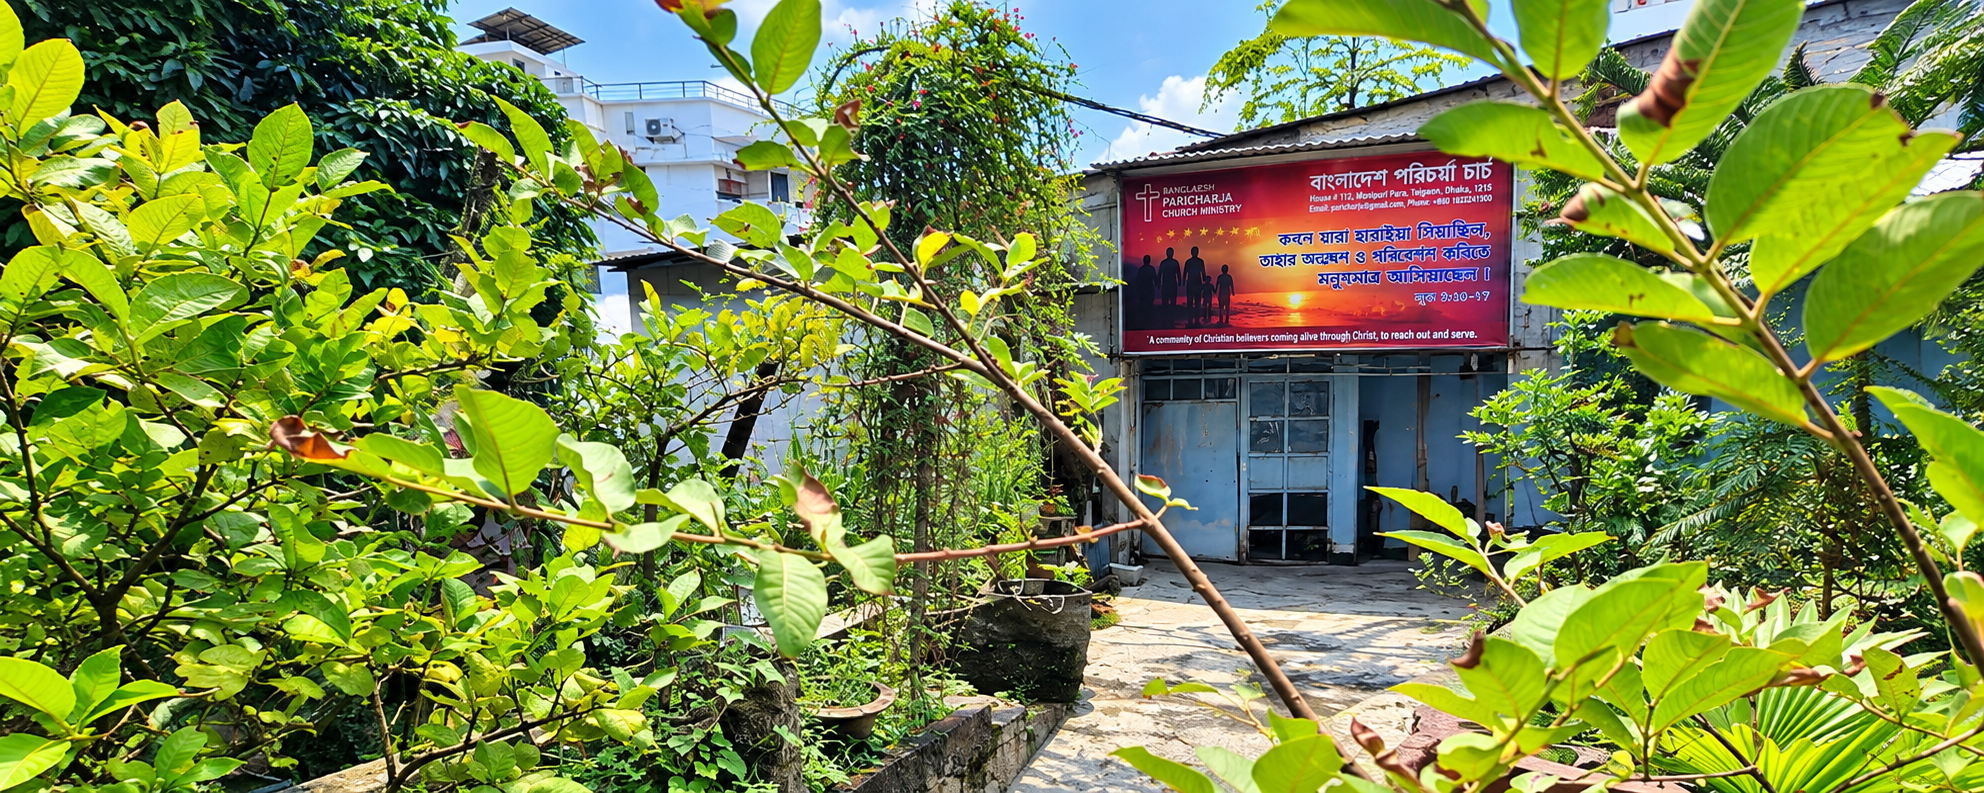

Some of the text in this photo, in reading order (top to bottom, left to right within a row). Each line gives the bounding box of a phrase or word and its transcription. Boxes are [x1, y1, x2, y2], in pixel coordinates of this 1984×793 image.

[1309, 168, 1388, 191] বাংলাদেশ
[1462, 156, 1493, 180] চার্চ
[1474, 183, 1493, 193] 1215
[1162, 192, 1233, 207] PARICHARJA
[1162, 204, 1242, 218] CHURCH MINISTRY
[1355, 250, 1366, 264] ও
[1194, 334, 1202, 343] of
[1203, 333, 1235, 343] Christian
[1270, 332, 1298, 343] coming
[1300, 331, 1319, 341] alive
[1320, 331, 1350, 343] through
[1352, 330, 1379, 342] Christ,
[1380, 330, 1389, 340] to
[1391, 329, 1412, 340] reach
[1416, 330, 1431, 339] out
[1432, 329, 1450, 339] and
[1451, 330, 1478, 339] serve.
